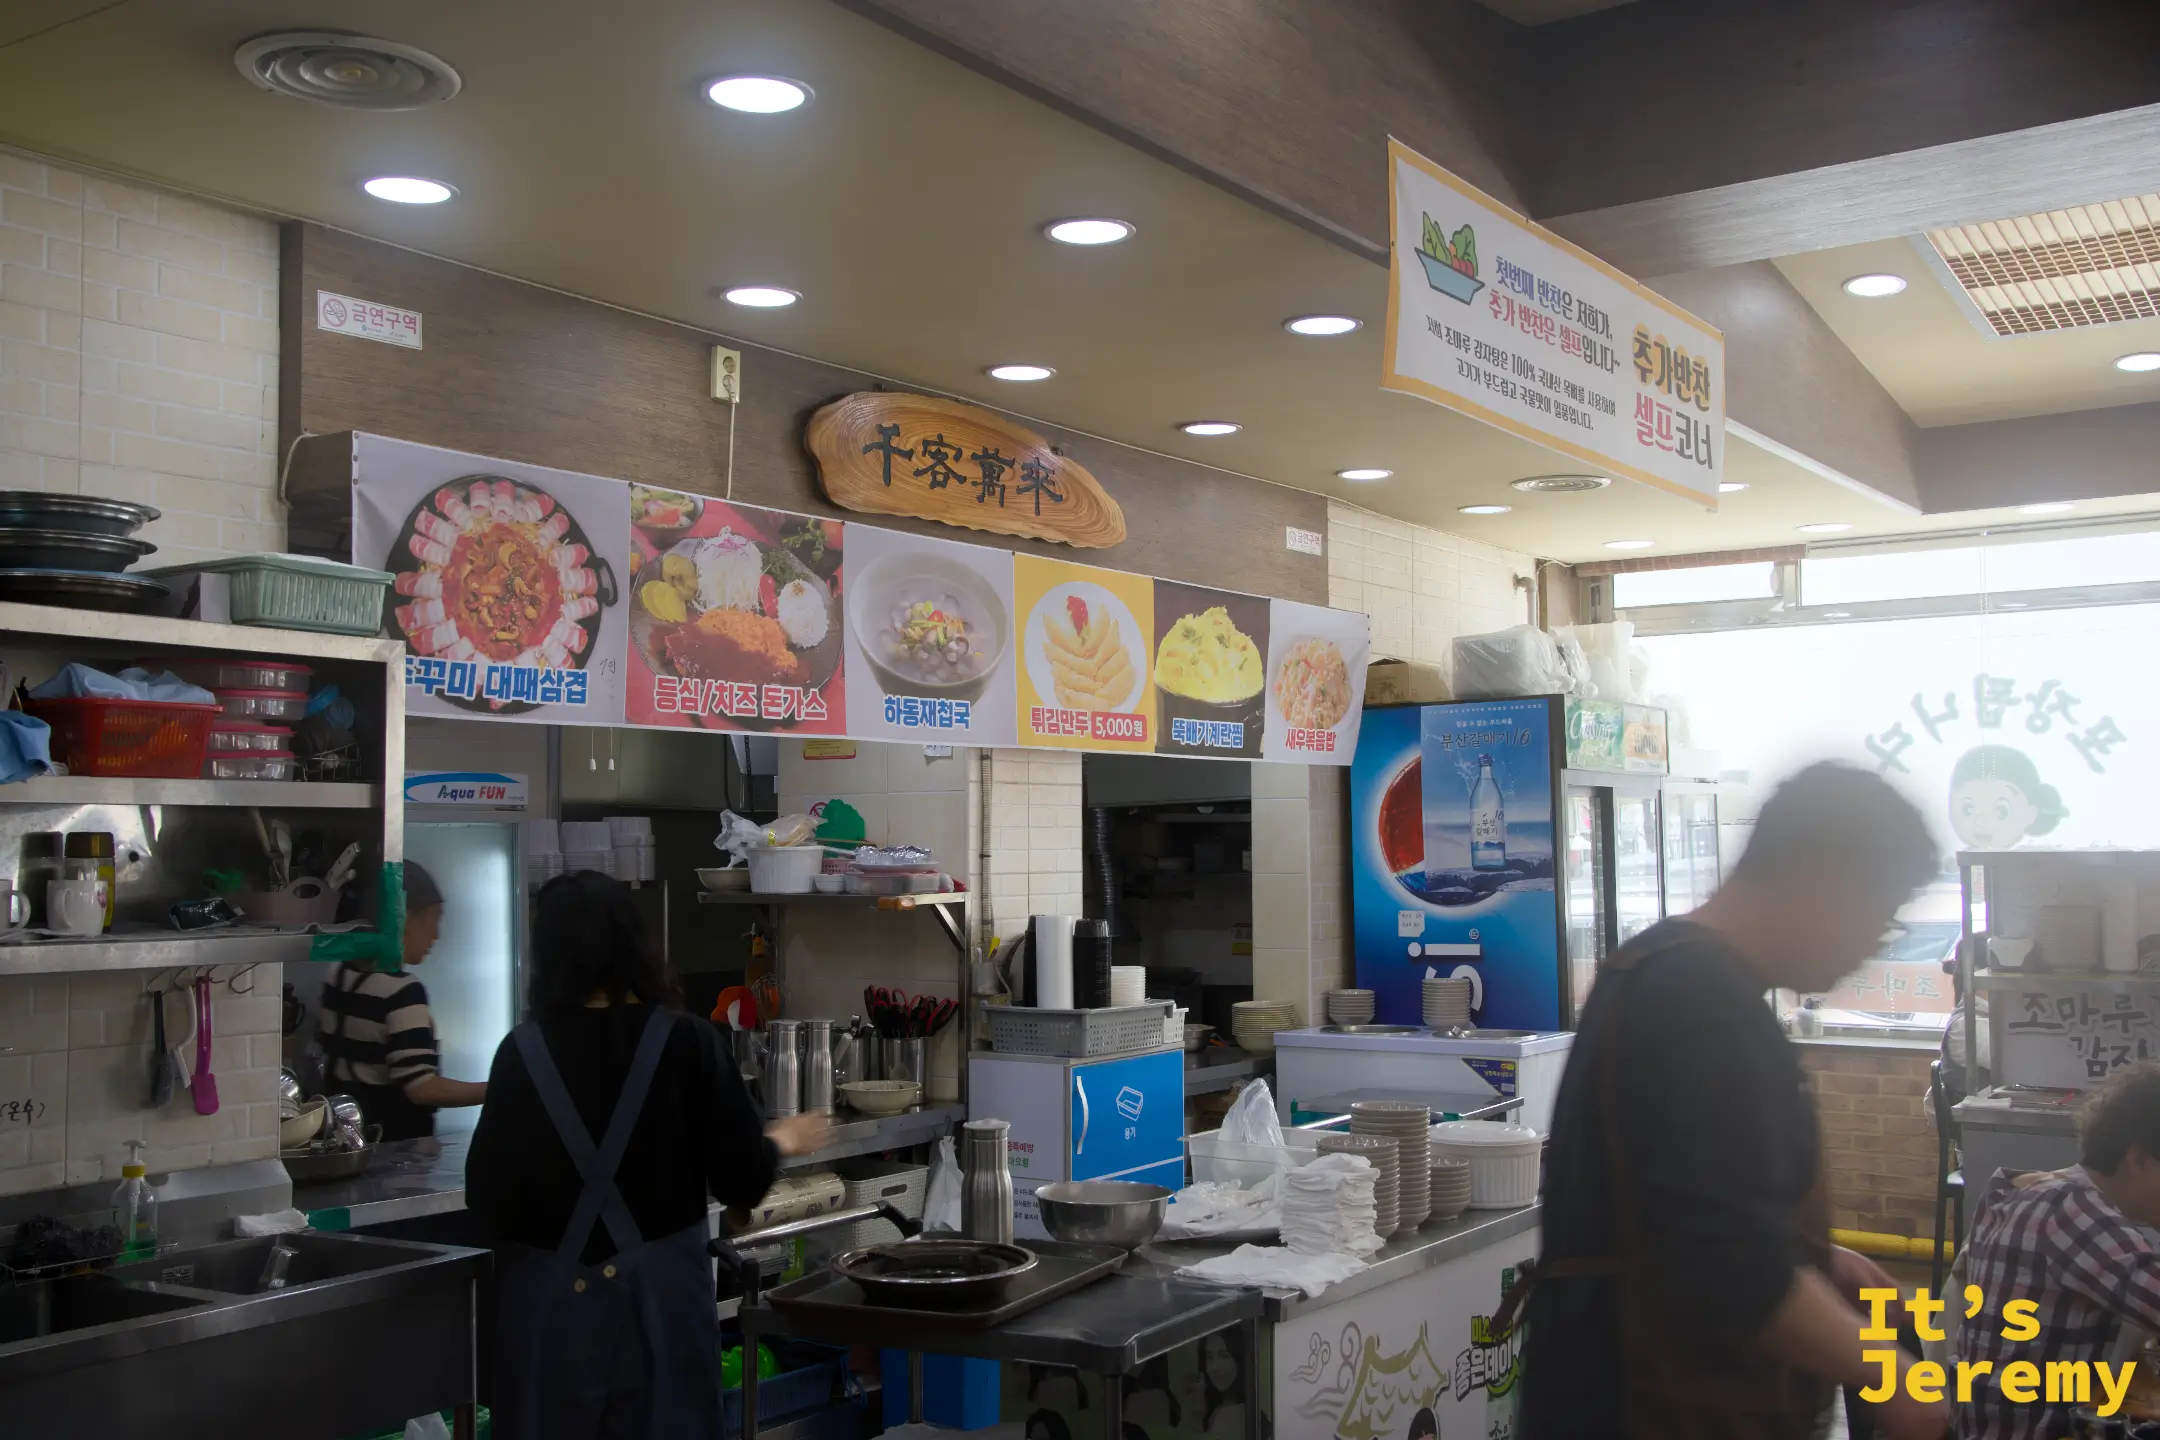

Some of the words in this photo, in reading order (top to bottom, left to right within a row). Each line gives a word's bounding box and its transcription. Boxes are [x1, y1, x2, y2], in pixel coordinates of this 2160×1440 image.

[352, 303, 416, 334] 금연구역
[1496, 256, 1534, 302] 첫번째
[1537, 278, 1573, 321] 반찬은
[1576, 298, 1613, 342] 저희가,
[1489, 289, 1515, 327] 추가
[1518, 303, 1557, 346] 반찬은
[1559, 324, 1620, 375] 셀프입니다~
[1425, 314, 1443, 340] 저희
[1444, 325, 1471, 354] 조마루
[1473, 339, 1509, 371] 감자탕은
[1511, 353, 1536, 383] 100%
[1538, 367, 1562, 394] 국내산
[1563, 379, 1585, 405] 목뼈를
[1587, 386, 1617, 417] 사용하여
[1632, 331, 1712, 413] 추가반찬
[1456, 357, 1481, 385] 고기가
[1483, 370, 1517, 400] 부드럽고
[1519, 385, 1552, 414] 국물맛이
[1553, 399, 1595, 431] 일품입니다.
[1633, 391, 1714, 470] 셀프코너
[862, 423, 1063, 516] 千客萬來
[484, 664, 589, 705] 대패삼겹
[655, 676, 757, 718] 등심/치즈
[761, 684, 827, 720] 돈가스
[884, 696, 971, 730] 하동재첩국
[1030, 707, 1088, 737] 튀김만두
[1096, 716, 1144, 738] 5,000원
[1171, 717, 1244, 748] 뚝배기계란찜
[1284, 728, 1337, 752] 새우볶음밥
[1441, 730, 1509, 749] 부산갈매기
[1512, 727, 1531, 746] 16
[438, 784, 475, 800] Aqua
[478, 785, 505, 800] FUN
[2008, 992, 2149, 1034] 조마루
[1124, 1126, 1137, 1141] 용기
[1455, 1337, 1513, 1402] 좋은데이
